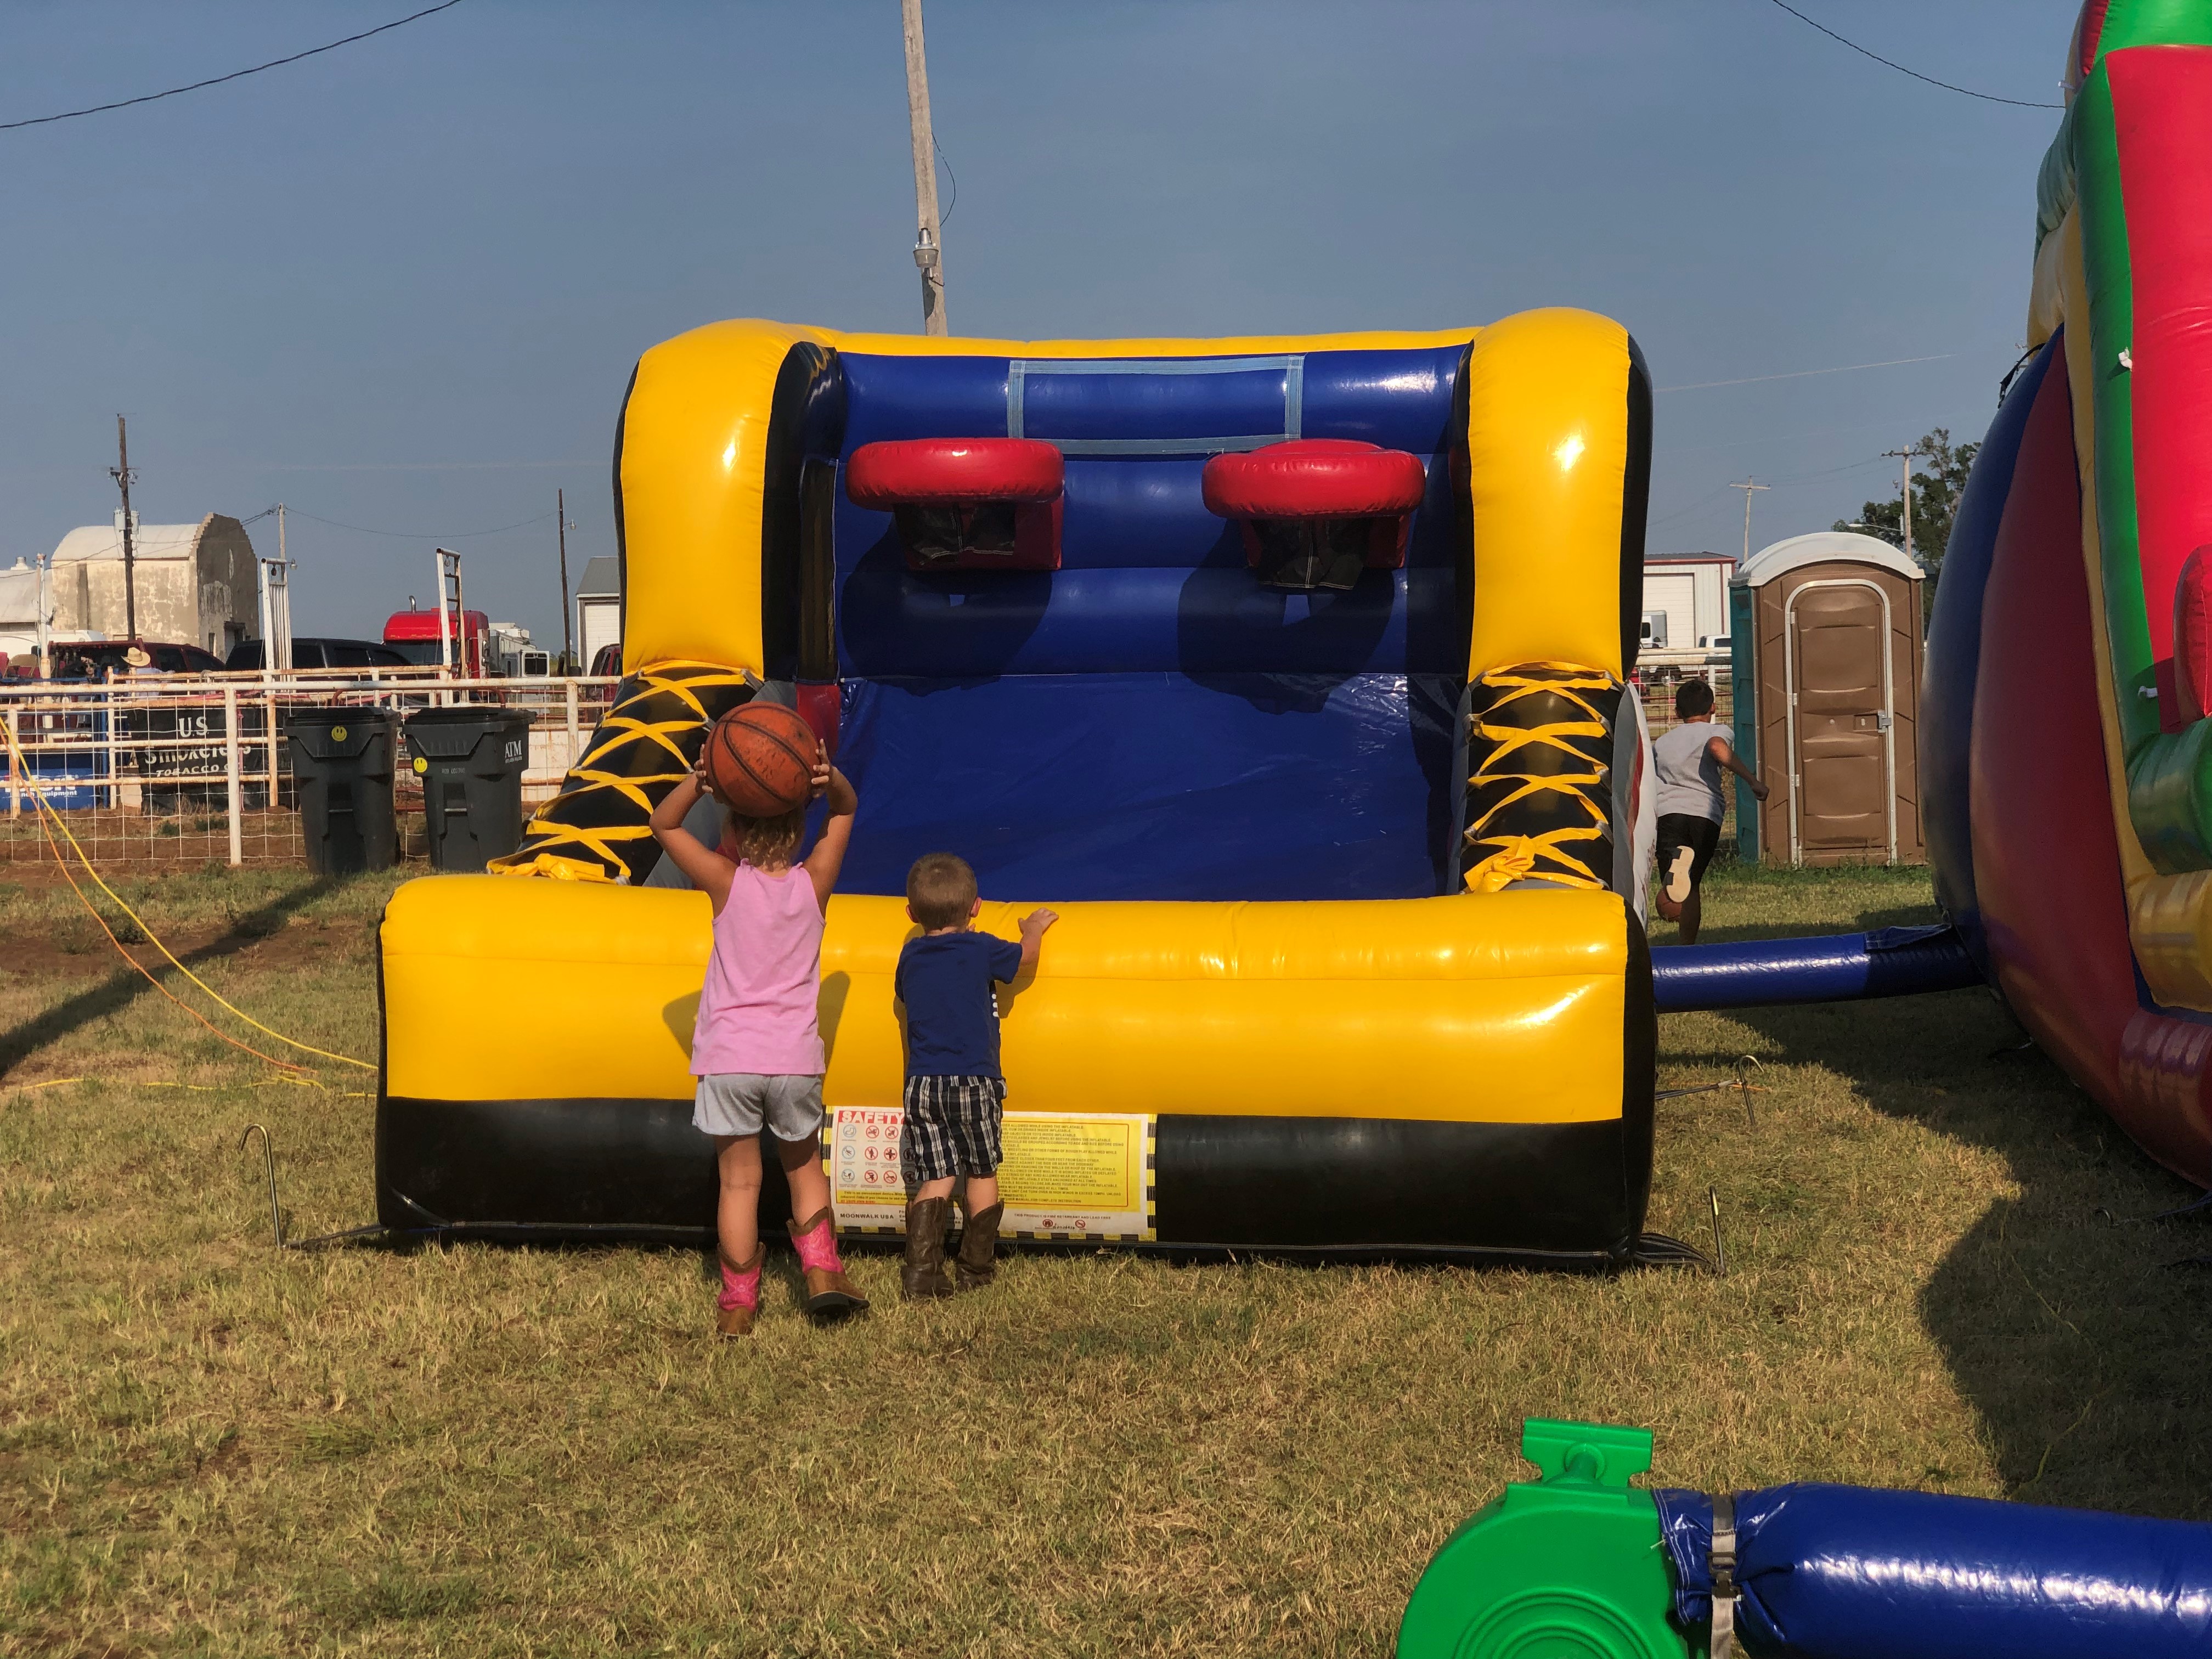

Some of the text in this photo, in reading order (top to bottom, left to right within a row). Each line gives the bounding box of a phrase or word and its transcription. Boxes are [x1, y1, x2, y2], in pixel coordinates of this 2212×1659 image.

[179, 716, 210, 737] U.S.
[145, 746, 251, 764] Smokeles
[505, 740, 522, 758] ATM
[156, 764, 219, 777] TOBACCO
[842, 1111, 905, 1125] SAFETY
